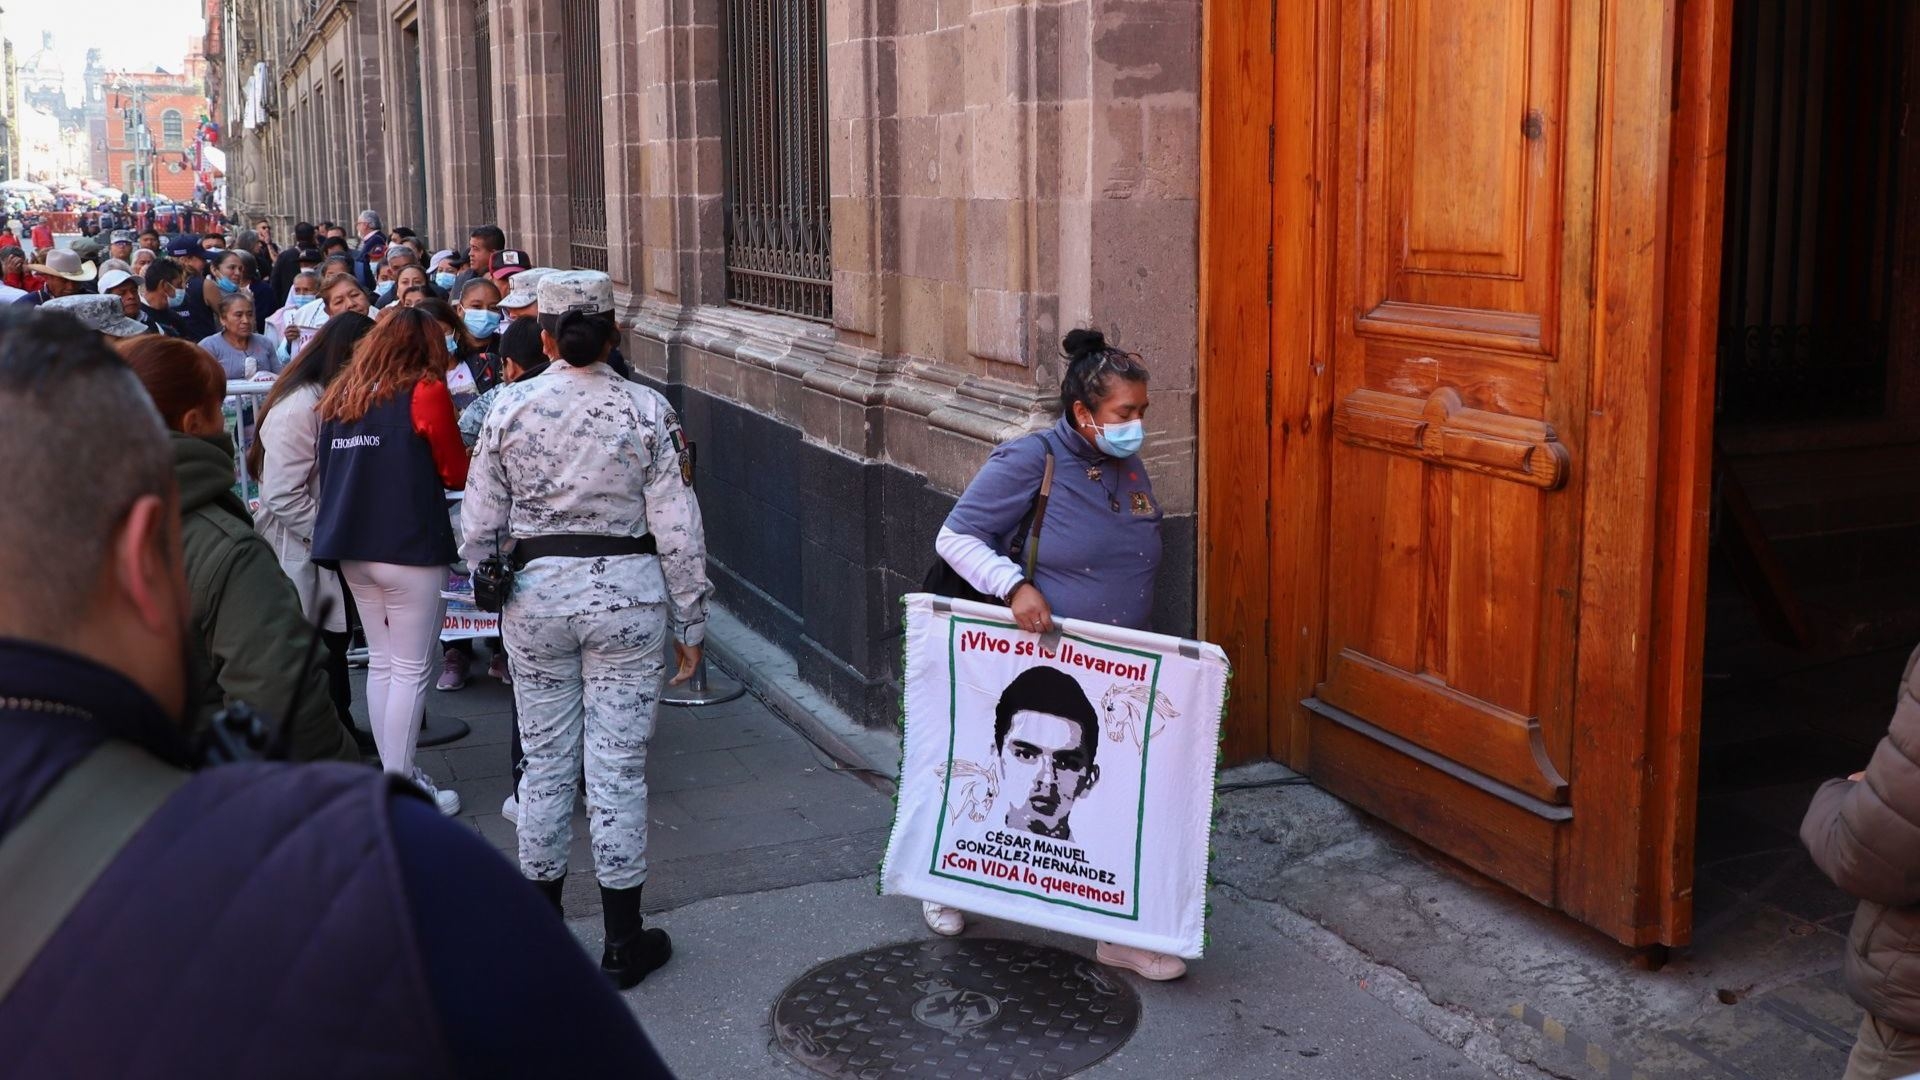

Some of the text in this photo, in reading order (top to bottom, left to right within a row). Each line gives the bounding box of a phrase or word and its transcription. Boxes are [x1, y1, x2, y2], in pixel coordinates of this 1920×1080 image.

[443, 616, 459, 629] DA
[461, 616, 471, 629] lo
[960, 630, 1010, 654] ¡Vivo
[1014, 640, 1034, 656] se
[1060, 643, 1147, 682] llevaron!
[955, 839, 1116, 885] GONZÁLEZ HERNÁNDEZ
[985, 830, 1090, 864] CÉSAR MANUEL
[942, 852, 1125, 905] ¡Con VIDA lo queremos!
